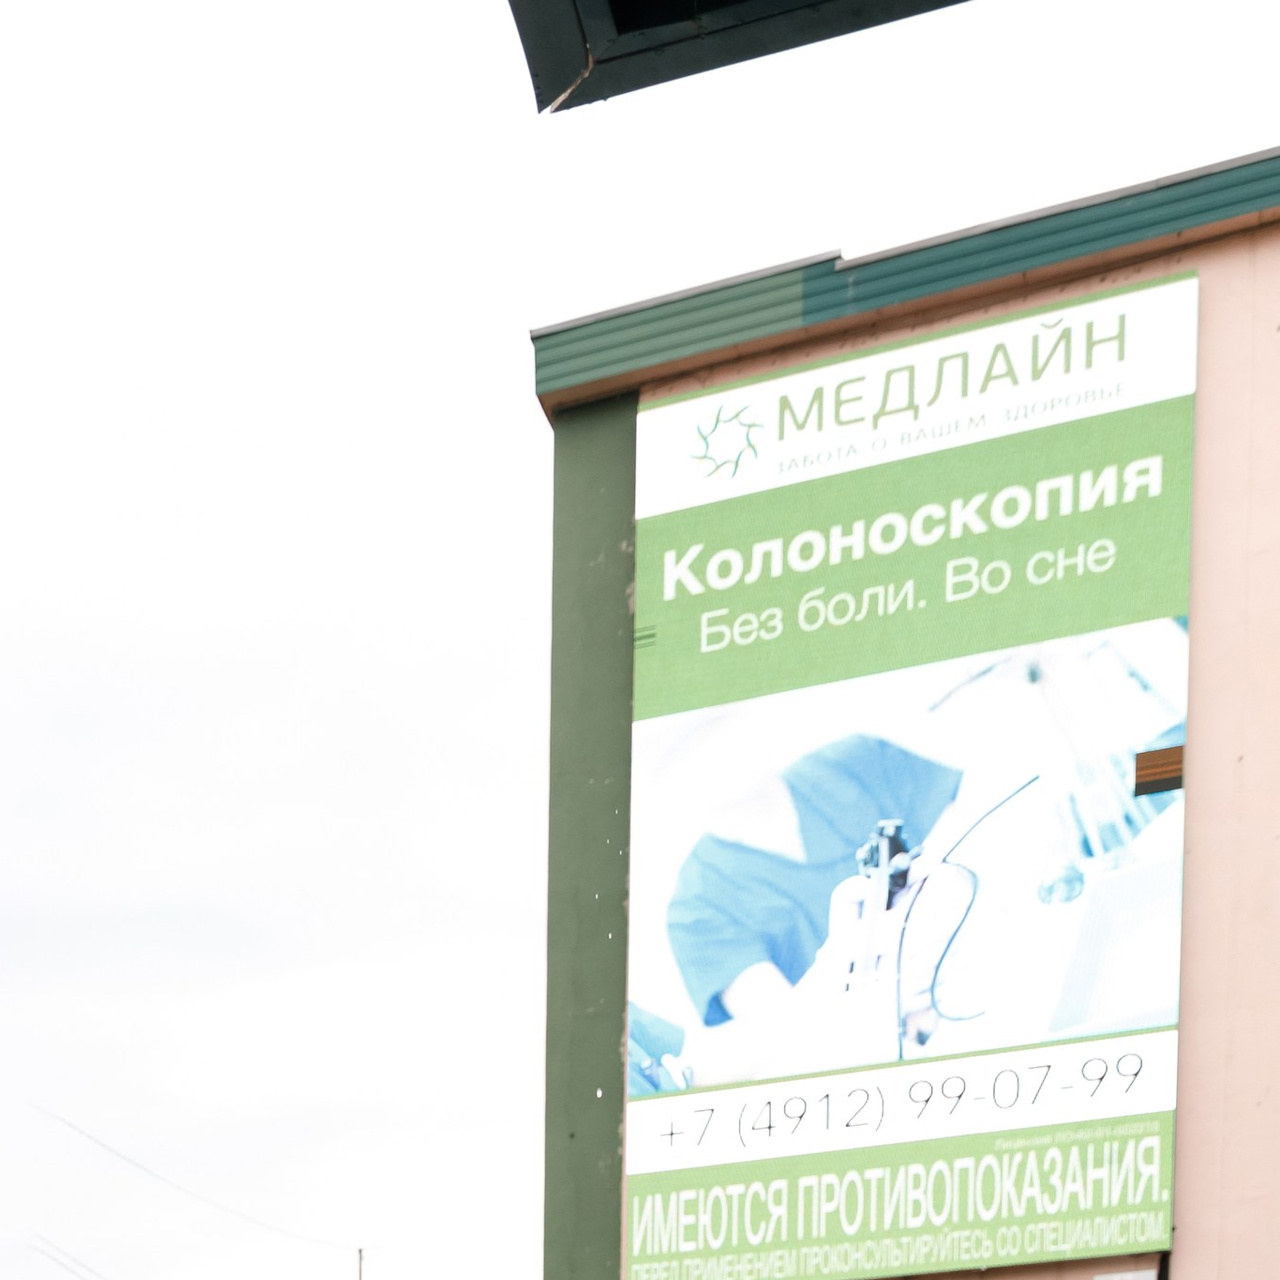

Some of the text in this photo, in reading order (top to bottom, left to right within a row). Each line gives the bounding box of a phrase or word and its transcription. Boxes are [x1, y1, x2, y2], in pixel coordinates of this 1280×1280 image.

[775, 381, 1127, 476] ЗАБОТА О ВАШЕМ ЗДОРОВЬЕ
[777, 313, 1127, 441] МЕДЛАЙН
[661, 455, 1164, 602] Колоноскопия
[699, 537, 1117, 653] Без боли. Во сне
[659, 1052, 1144, 1148] +7 (4912) 99-07-99
[632, 1134, 1169, 1258] ИМЕЮТСЯ ПРОТИВОПОКАЗАНИЯ.
[800, 1226, 993, 1276] ПРОКОНСУЛЬТИРУЙТЕСЬ
[996, 1223, 1020, 1258] СО
